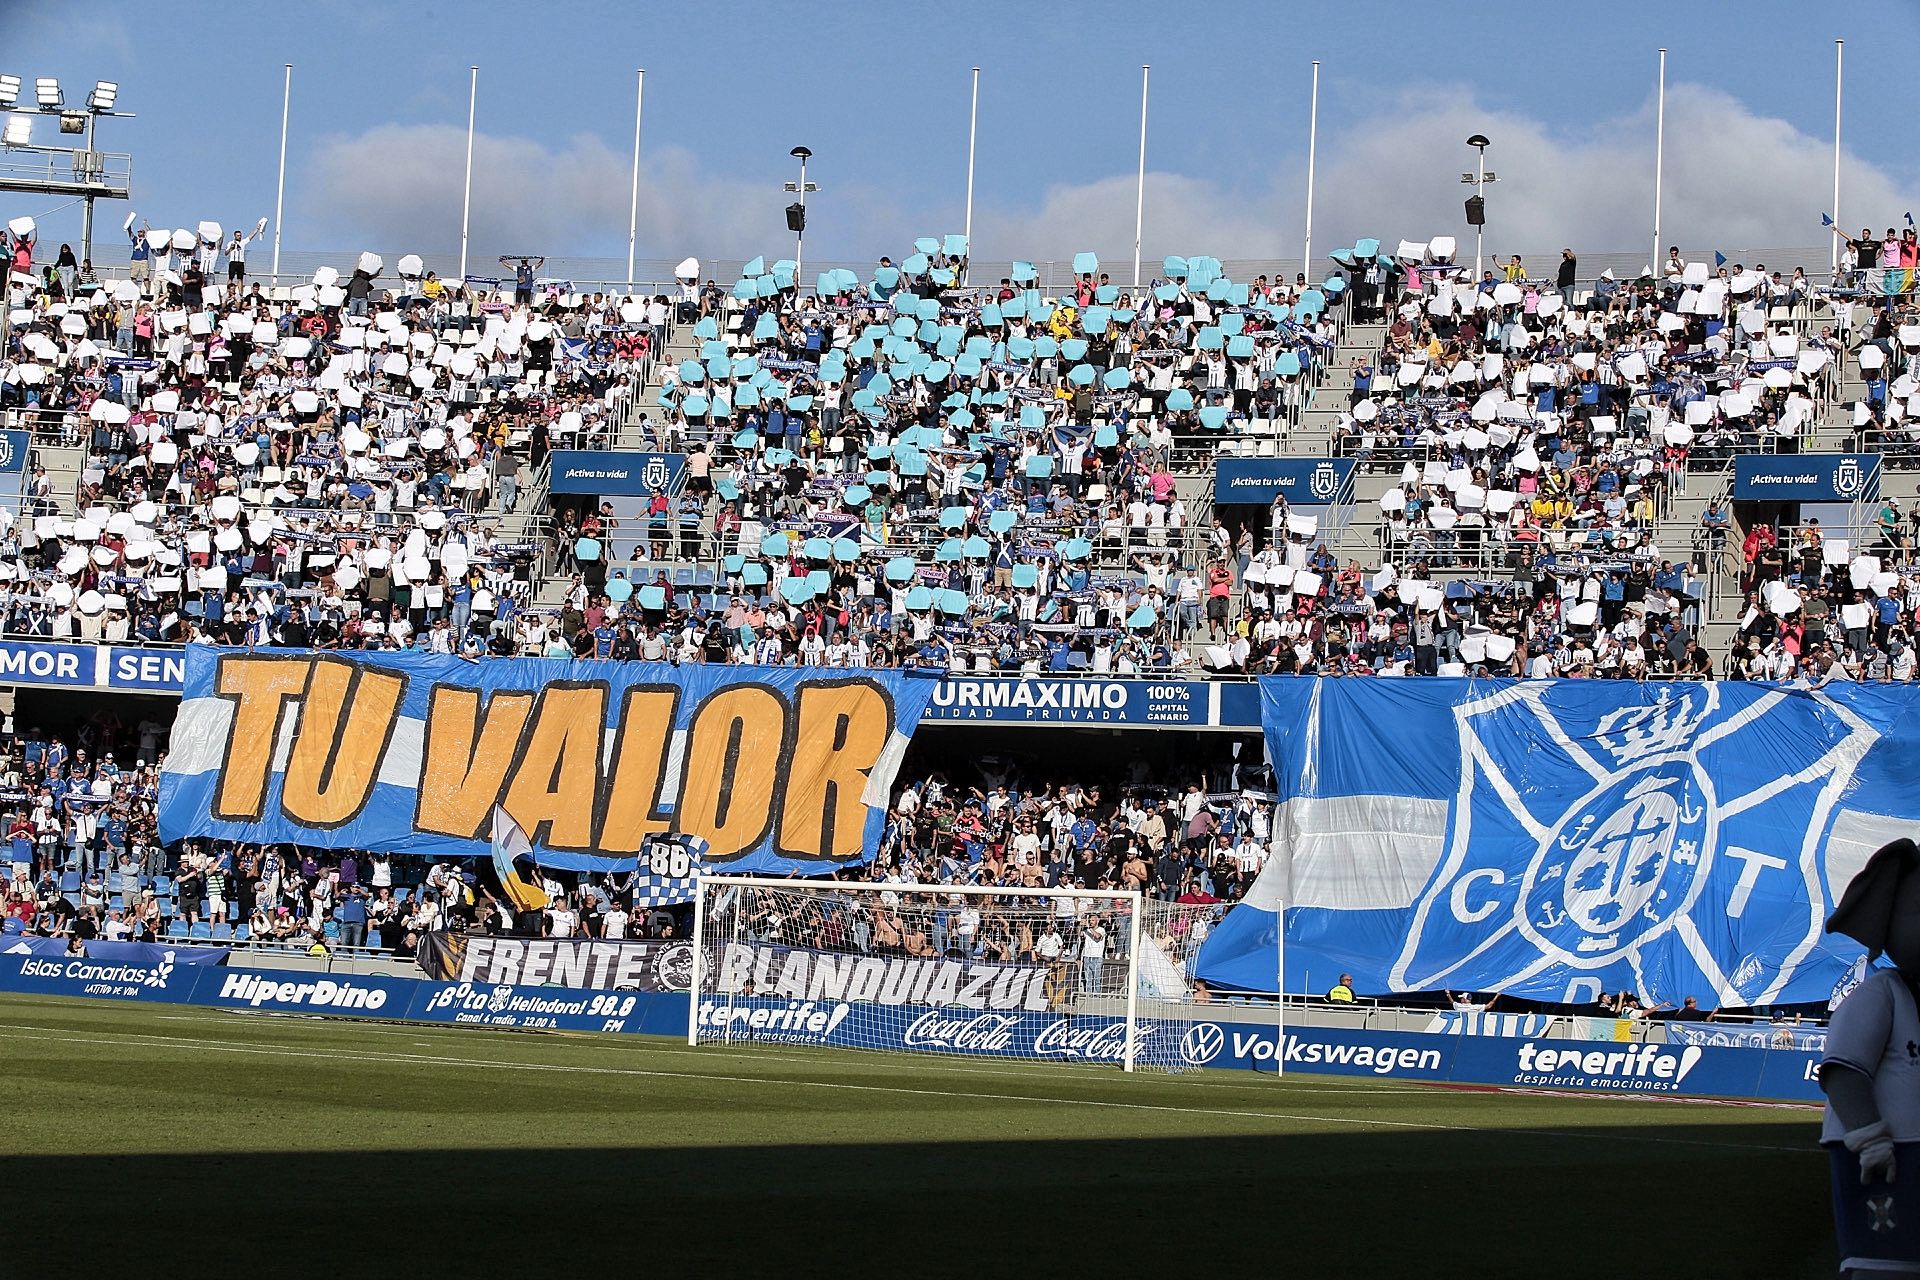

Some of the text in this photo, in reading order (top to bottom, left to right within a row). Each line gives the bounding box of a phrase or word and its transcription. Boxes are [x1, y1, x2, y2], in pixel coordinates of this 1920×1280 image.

[565, 468, 628, 479] ¡Activa tu vida!
[1750, 474, 1818, 486] ¡Activa tu vida!
[1231, 477, 1296, 488] ¡Activa tu vida!
[0, 649, 79, 679] MOR
[117, 656, 185, 683] SEN
[1146, 686, 1190, 701] 100%
[1026, 708, 1128, 721] PRIVADA
[1149, 704, 1189, 713] CAPITAL
[1147, 713, 1190, 722] CANARIO
[214, 653, 897, 863] TU VALOR
[19, 958, 147, 984] Islas Canarias
[461, 937, 649, 991] FRENTE
[717, 941, 1051, 1012] BLANQUIAZUL
[84, 983, 139, 997] LATITUD DE VIDA
[219, 972, 388, 1010] HiperDino
[587, 995, 637, 1017] 98.8
[455, 1012, 557, 1028] Canal 4 radio 13.00 h.
[602, 1019, 626, 1033] FM
[754, 1032, 819, 1043] emociones
[904, 1010, 1026, 1050] Coca-Cola
[1232, 1032, 1442, 1075] Volkswagen
[1514, 1073, 1669, 1092] despierta emociones
